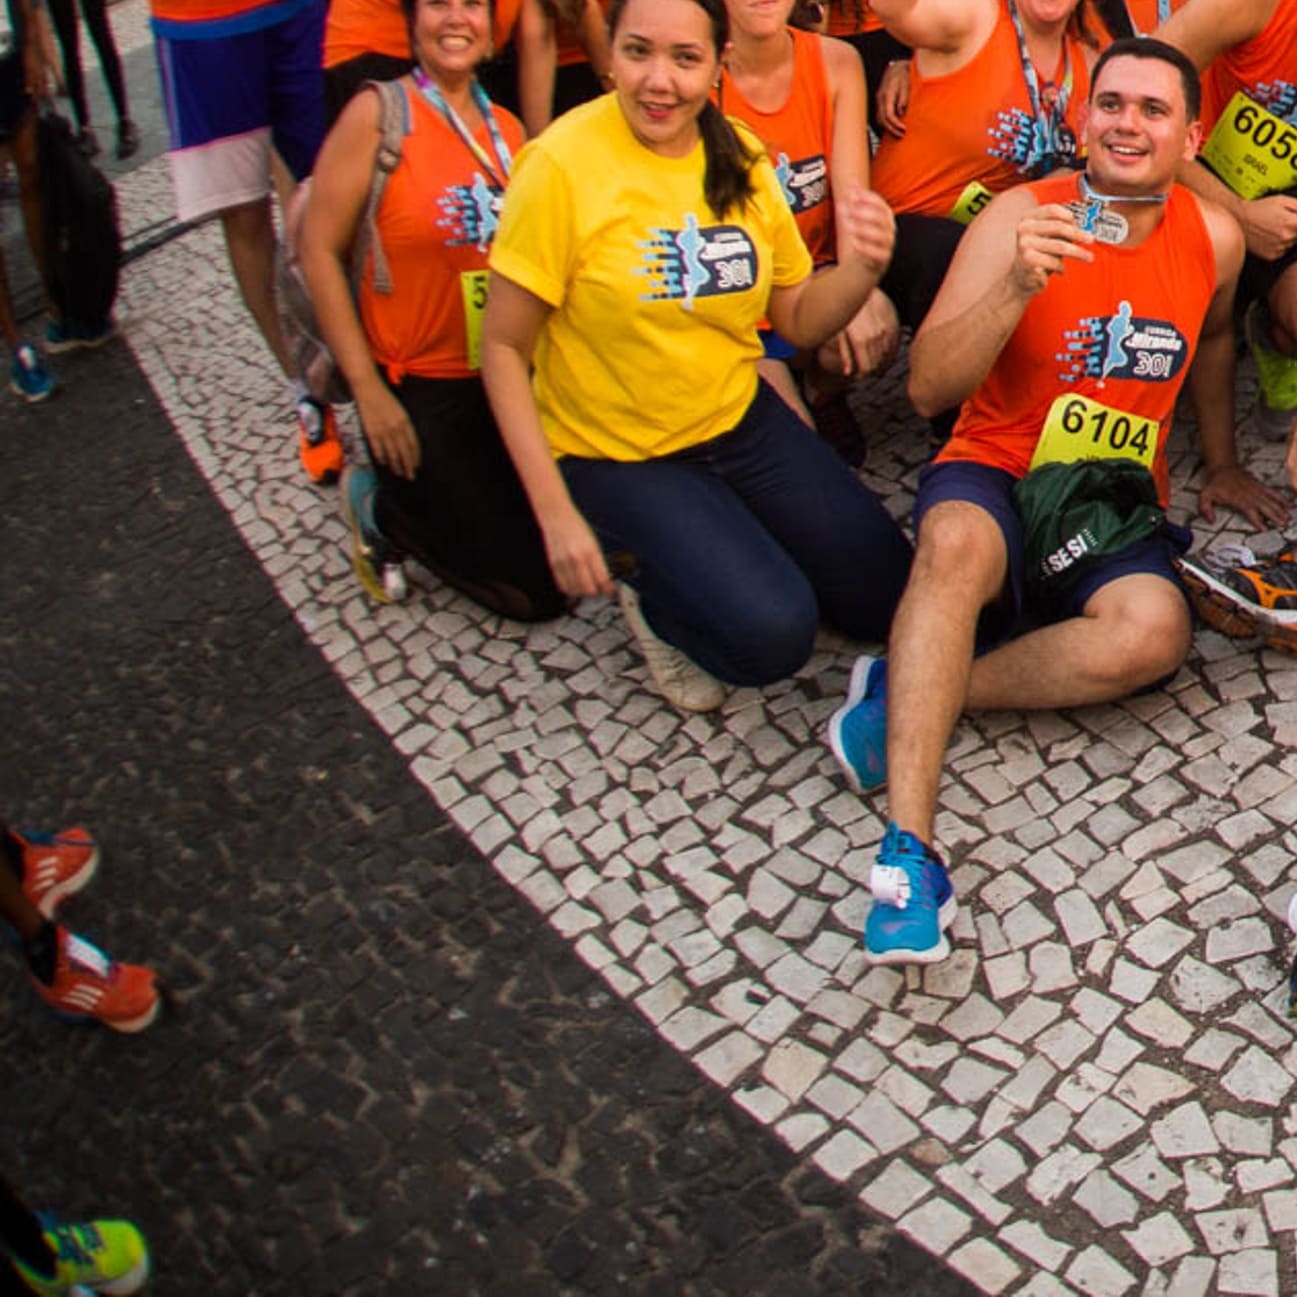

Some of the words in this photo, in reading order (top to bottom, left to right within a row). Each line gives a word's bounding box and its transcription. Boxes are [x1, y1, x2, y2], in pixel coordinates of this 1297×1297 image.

[1134, 351, 1166, 377] 30
[1062, 400, 1149, 457] 6104
[1048, 532, 1089, 573] SESI
